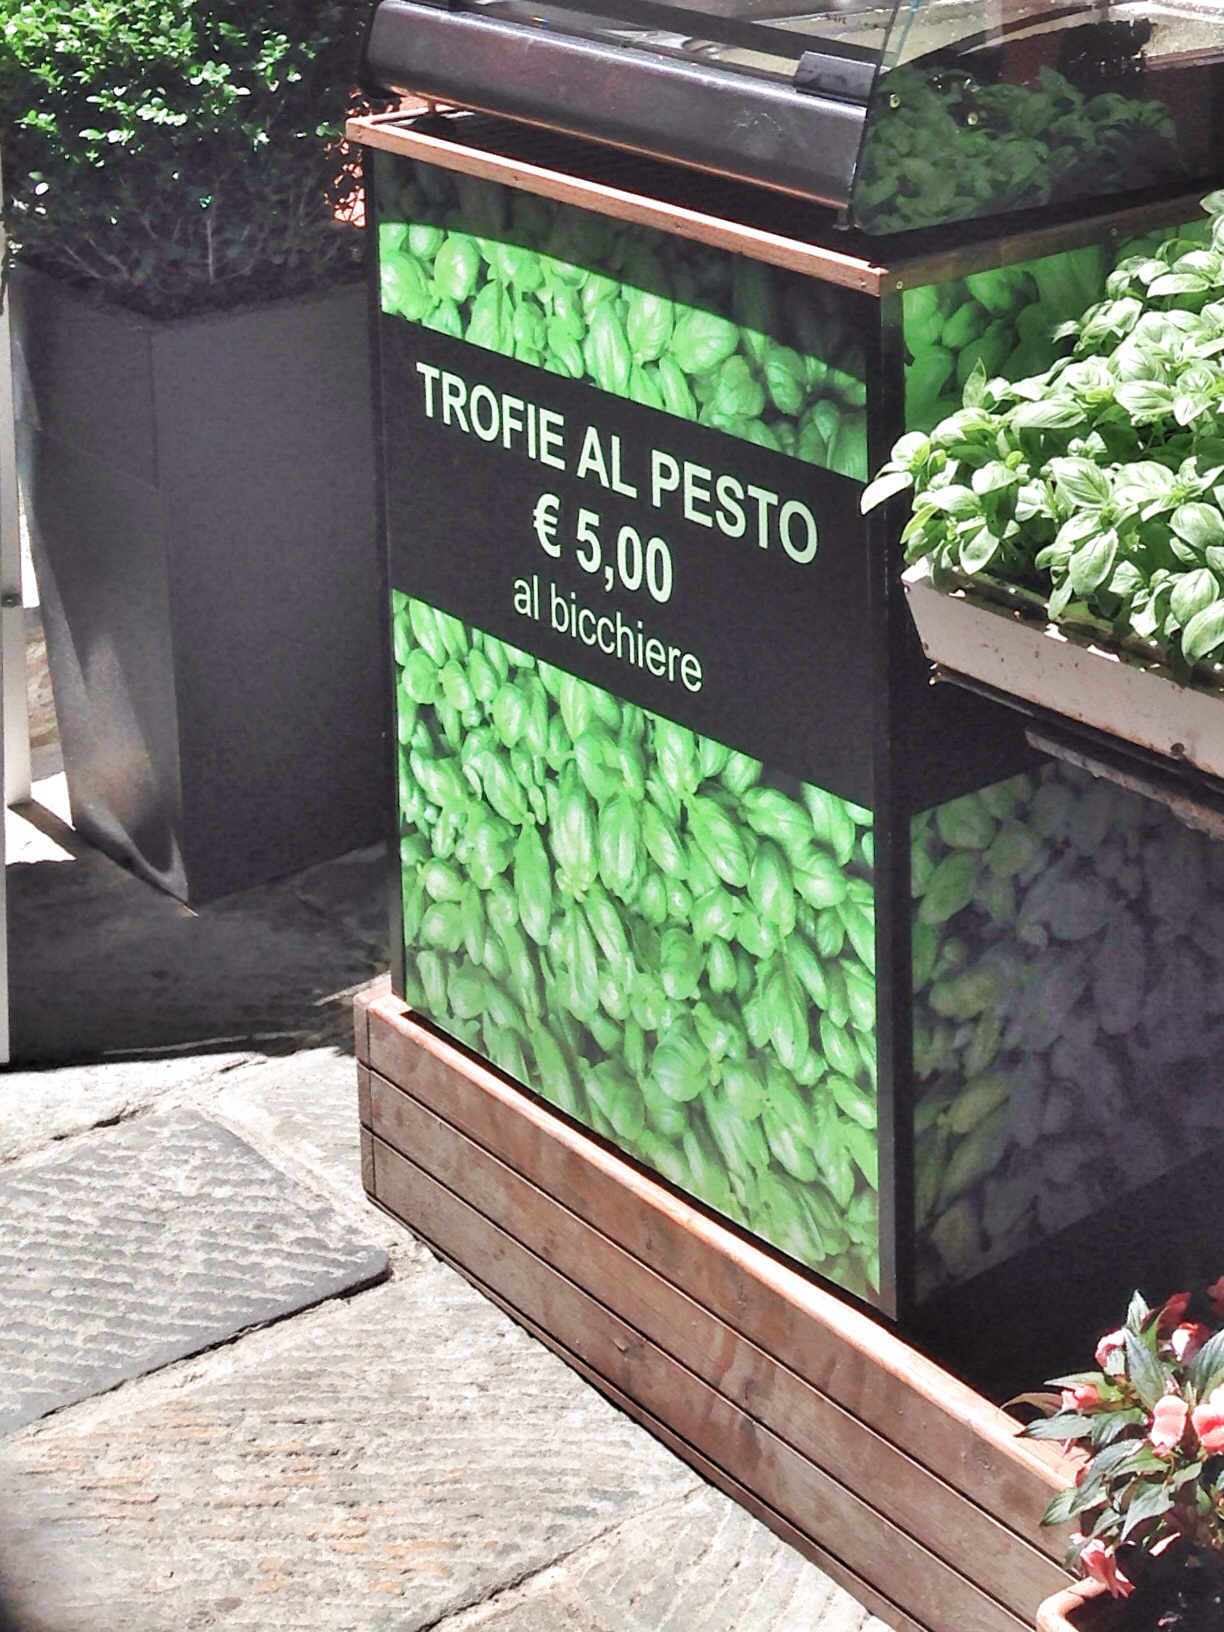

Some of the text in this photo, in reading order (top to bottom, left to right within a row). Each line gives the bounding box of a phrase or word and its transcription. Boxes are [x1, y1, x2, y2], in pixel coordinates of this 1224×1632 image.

[416, 361, 820, 565] TROFIE AL PESTO
[532, 492, 675, 604] € 5,00
[513, 574, 704, 694] al bicchiere
